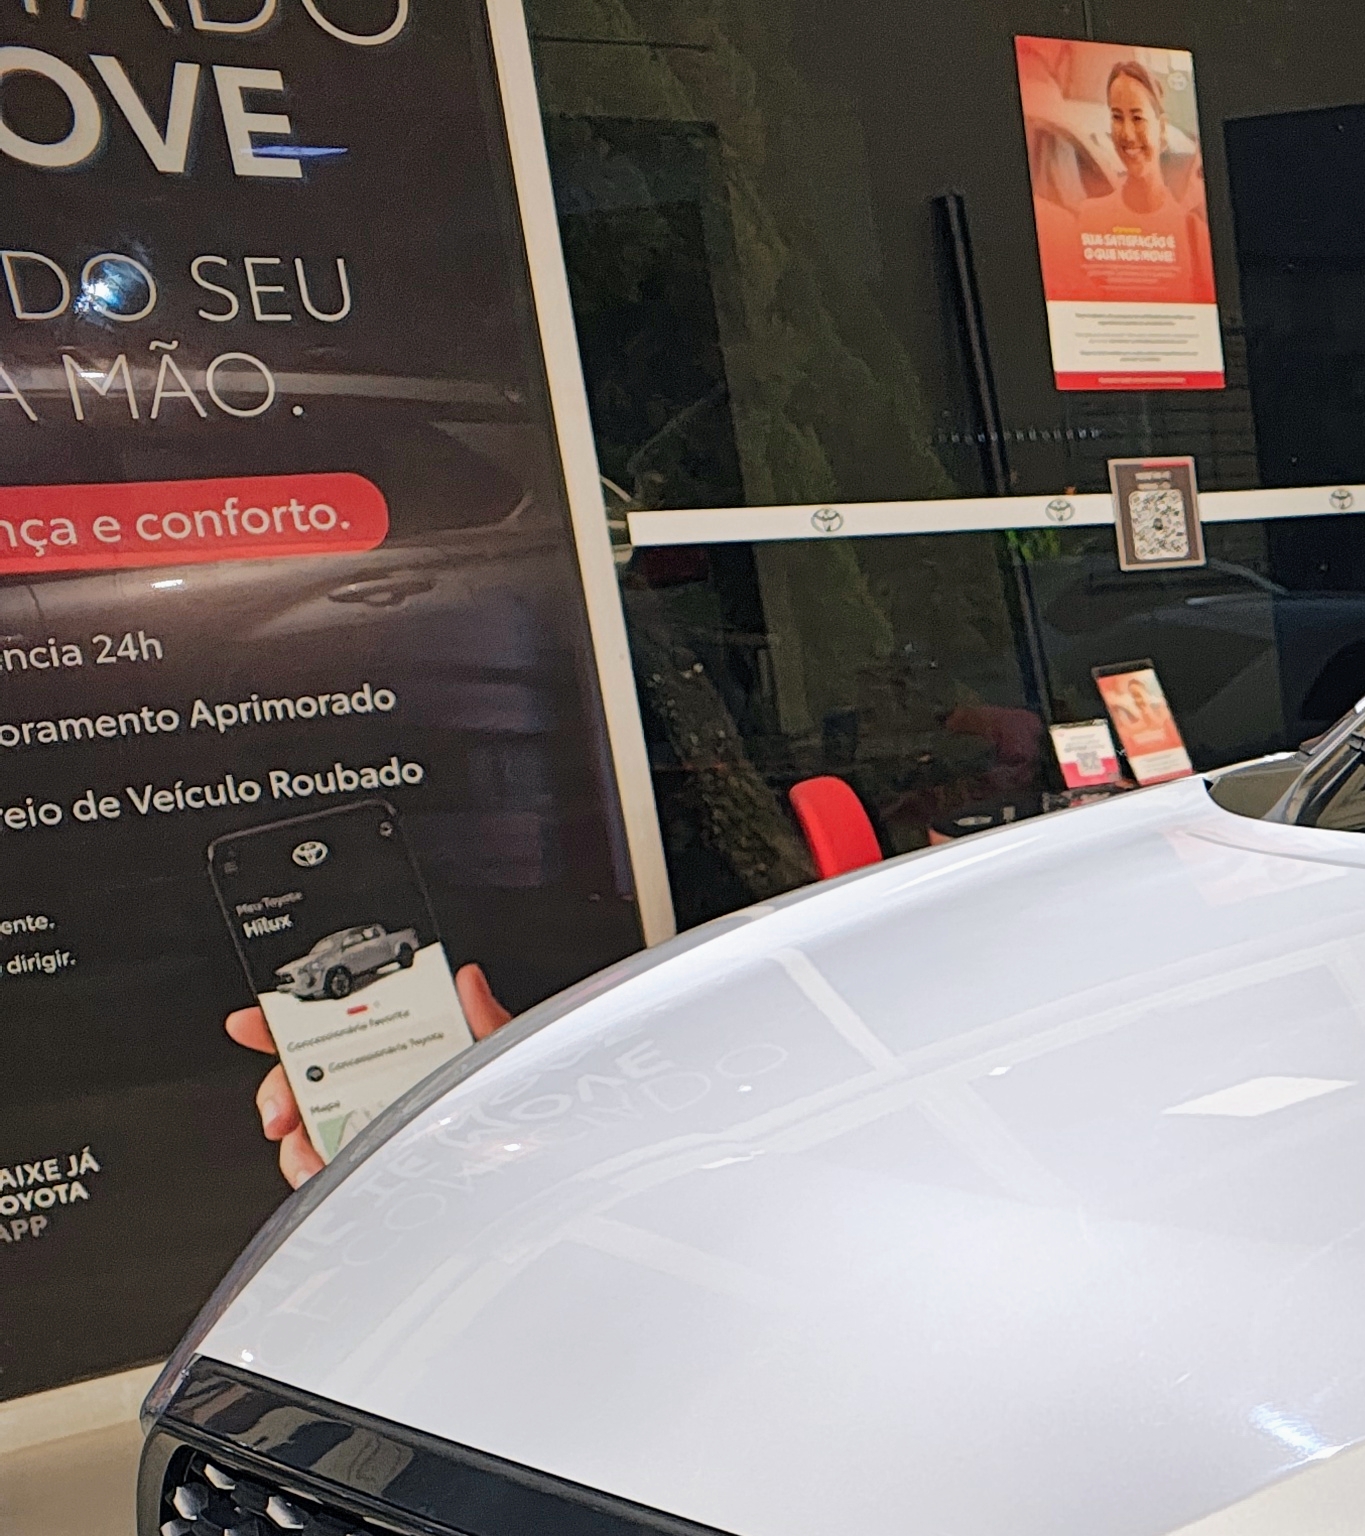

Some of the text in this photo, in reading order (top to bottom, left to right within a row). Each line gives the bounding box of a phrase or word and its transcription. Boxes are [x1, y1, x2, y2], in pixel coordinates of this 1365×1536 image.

[190, 256, 352, 322] SEU
[62, 340, 304, 421] MÃO.
[92, 516, 122, 543] e
[135, 497, 351, 544] conforto.
[0, 630, 163, 671] ncia 24h
[189, 682, 397, 734] Aprimorado
[0, 755, 424, 830] eio de Veículo Roubado
[242, 913, 294, 939] Hilux
[6, 949, 77, 975] dirigir.
[66, 1145, 101, 1178] JÁ
